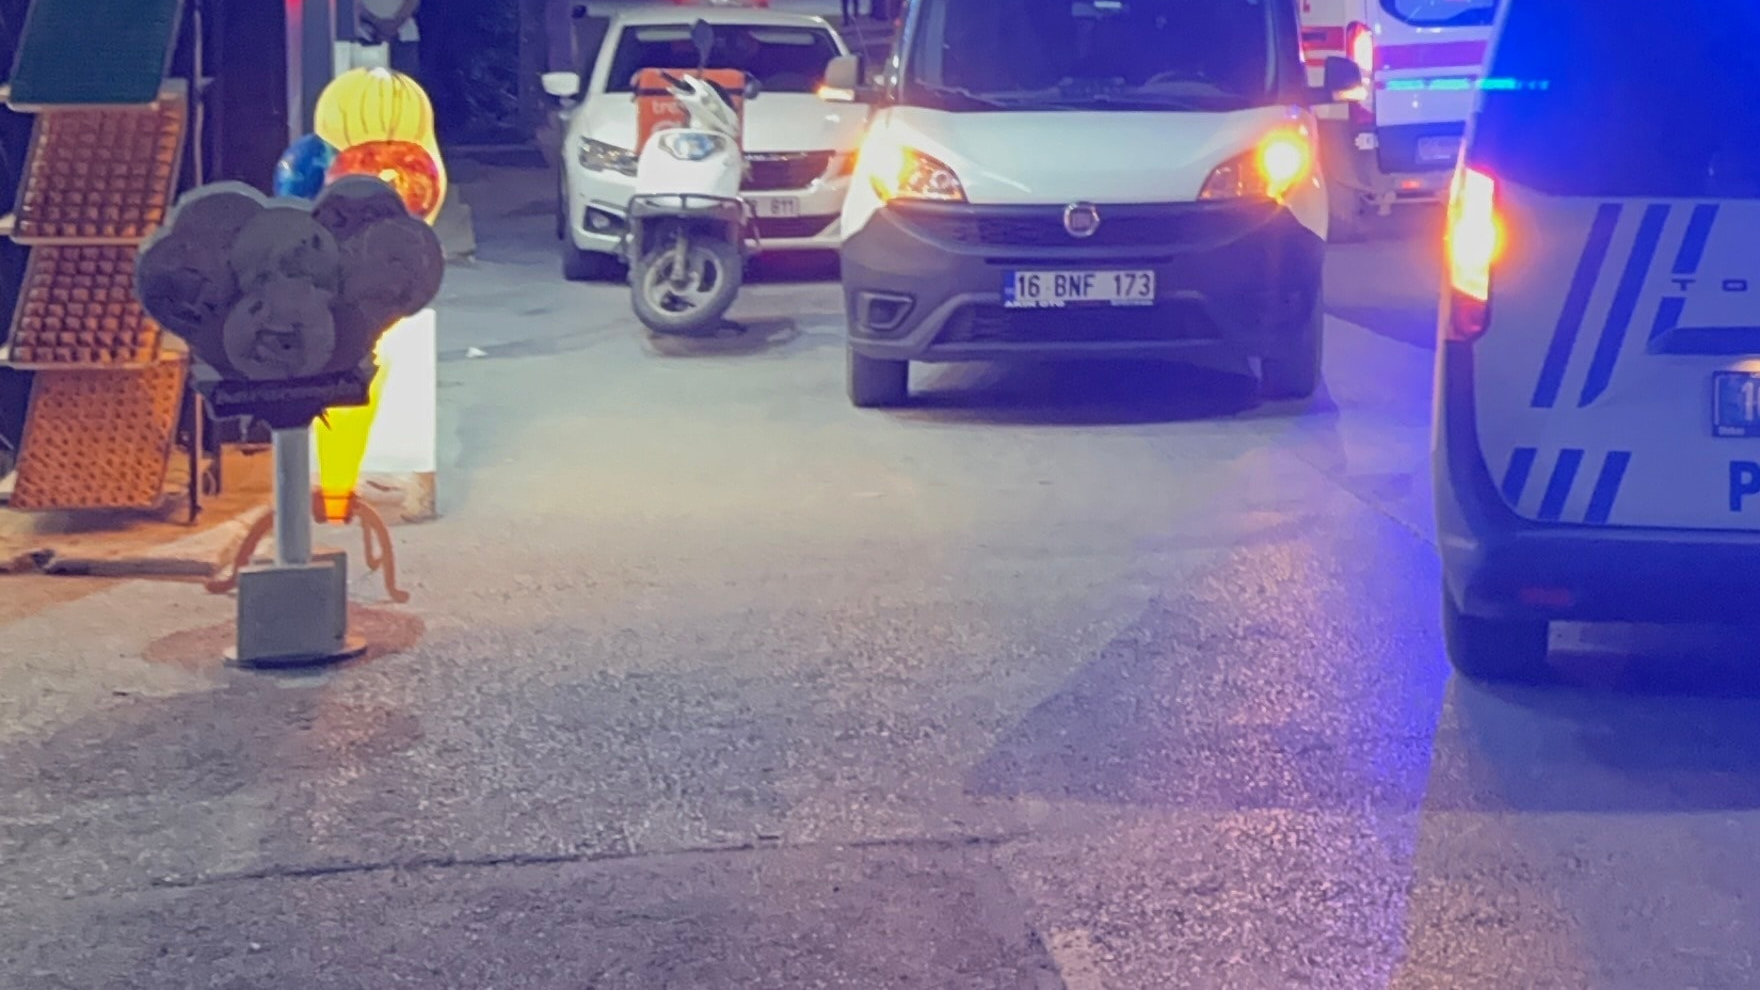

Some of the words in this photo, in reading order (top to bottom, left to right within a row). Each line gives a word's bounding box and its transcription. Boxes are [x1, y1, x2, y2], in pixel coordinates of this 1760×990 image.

[1018, 274, 1041, 298] 16
[1054, 274, 1097, 298] BNF
[1113, 273, 1151, 297] 173
